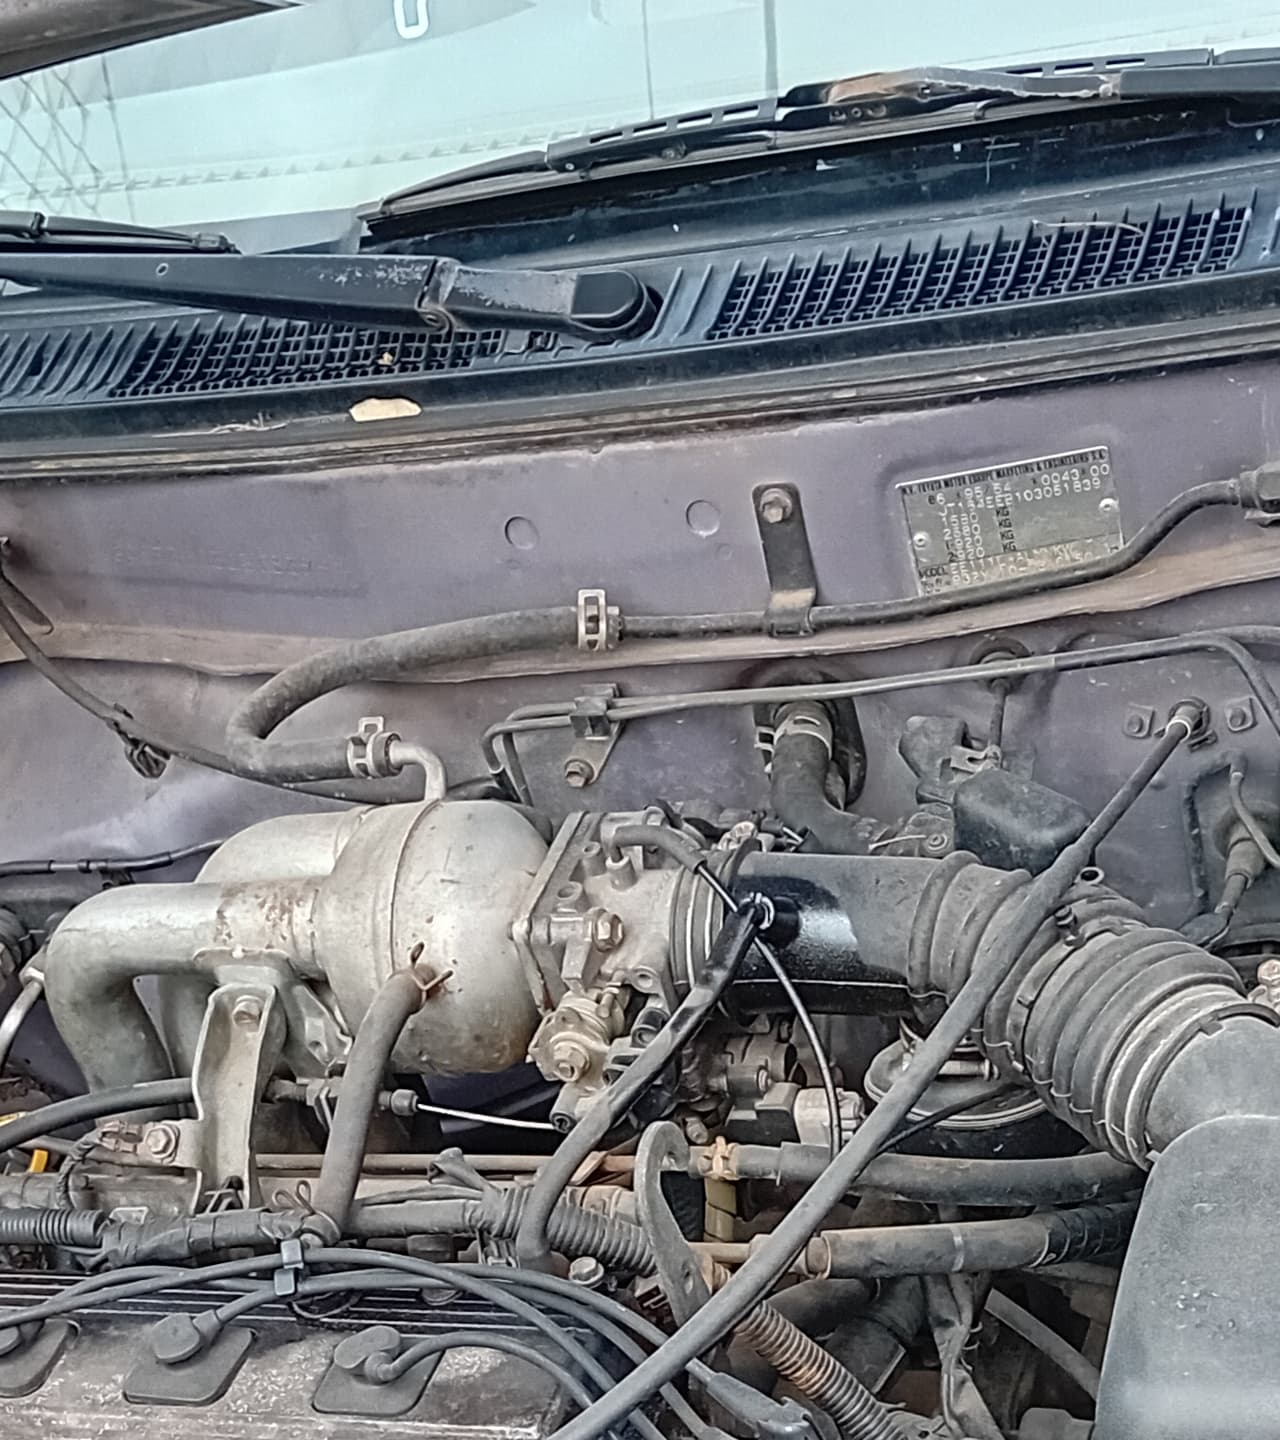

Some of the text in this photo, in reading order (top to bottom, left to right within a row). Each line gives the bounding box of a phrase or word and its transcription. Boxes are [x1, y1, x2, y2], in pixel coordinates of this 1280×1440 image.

[998, 517, 1013, 529] KG
[1000, 529, 1015, 541] KG
[1002, 541, 1017, 553] KG
